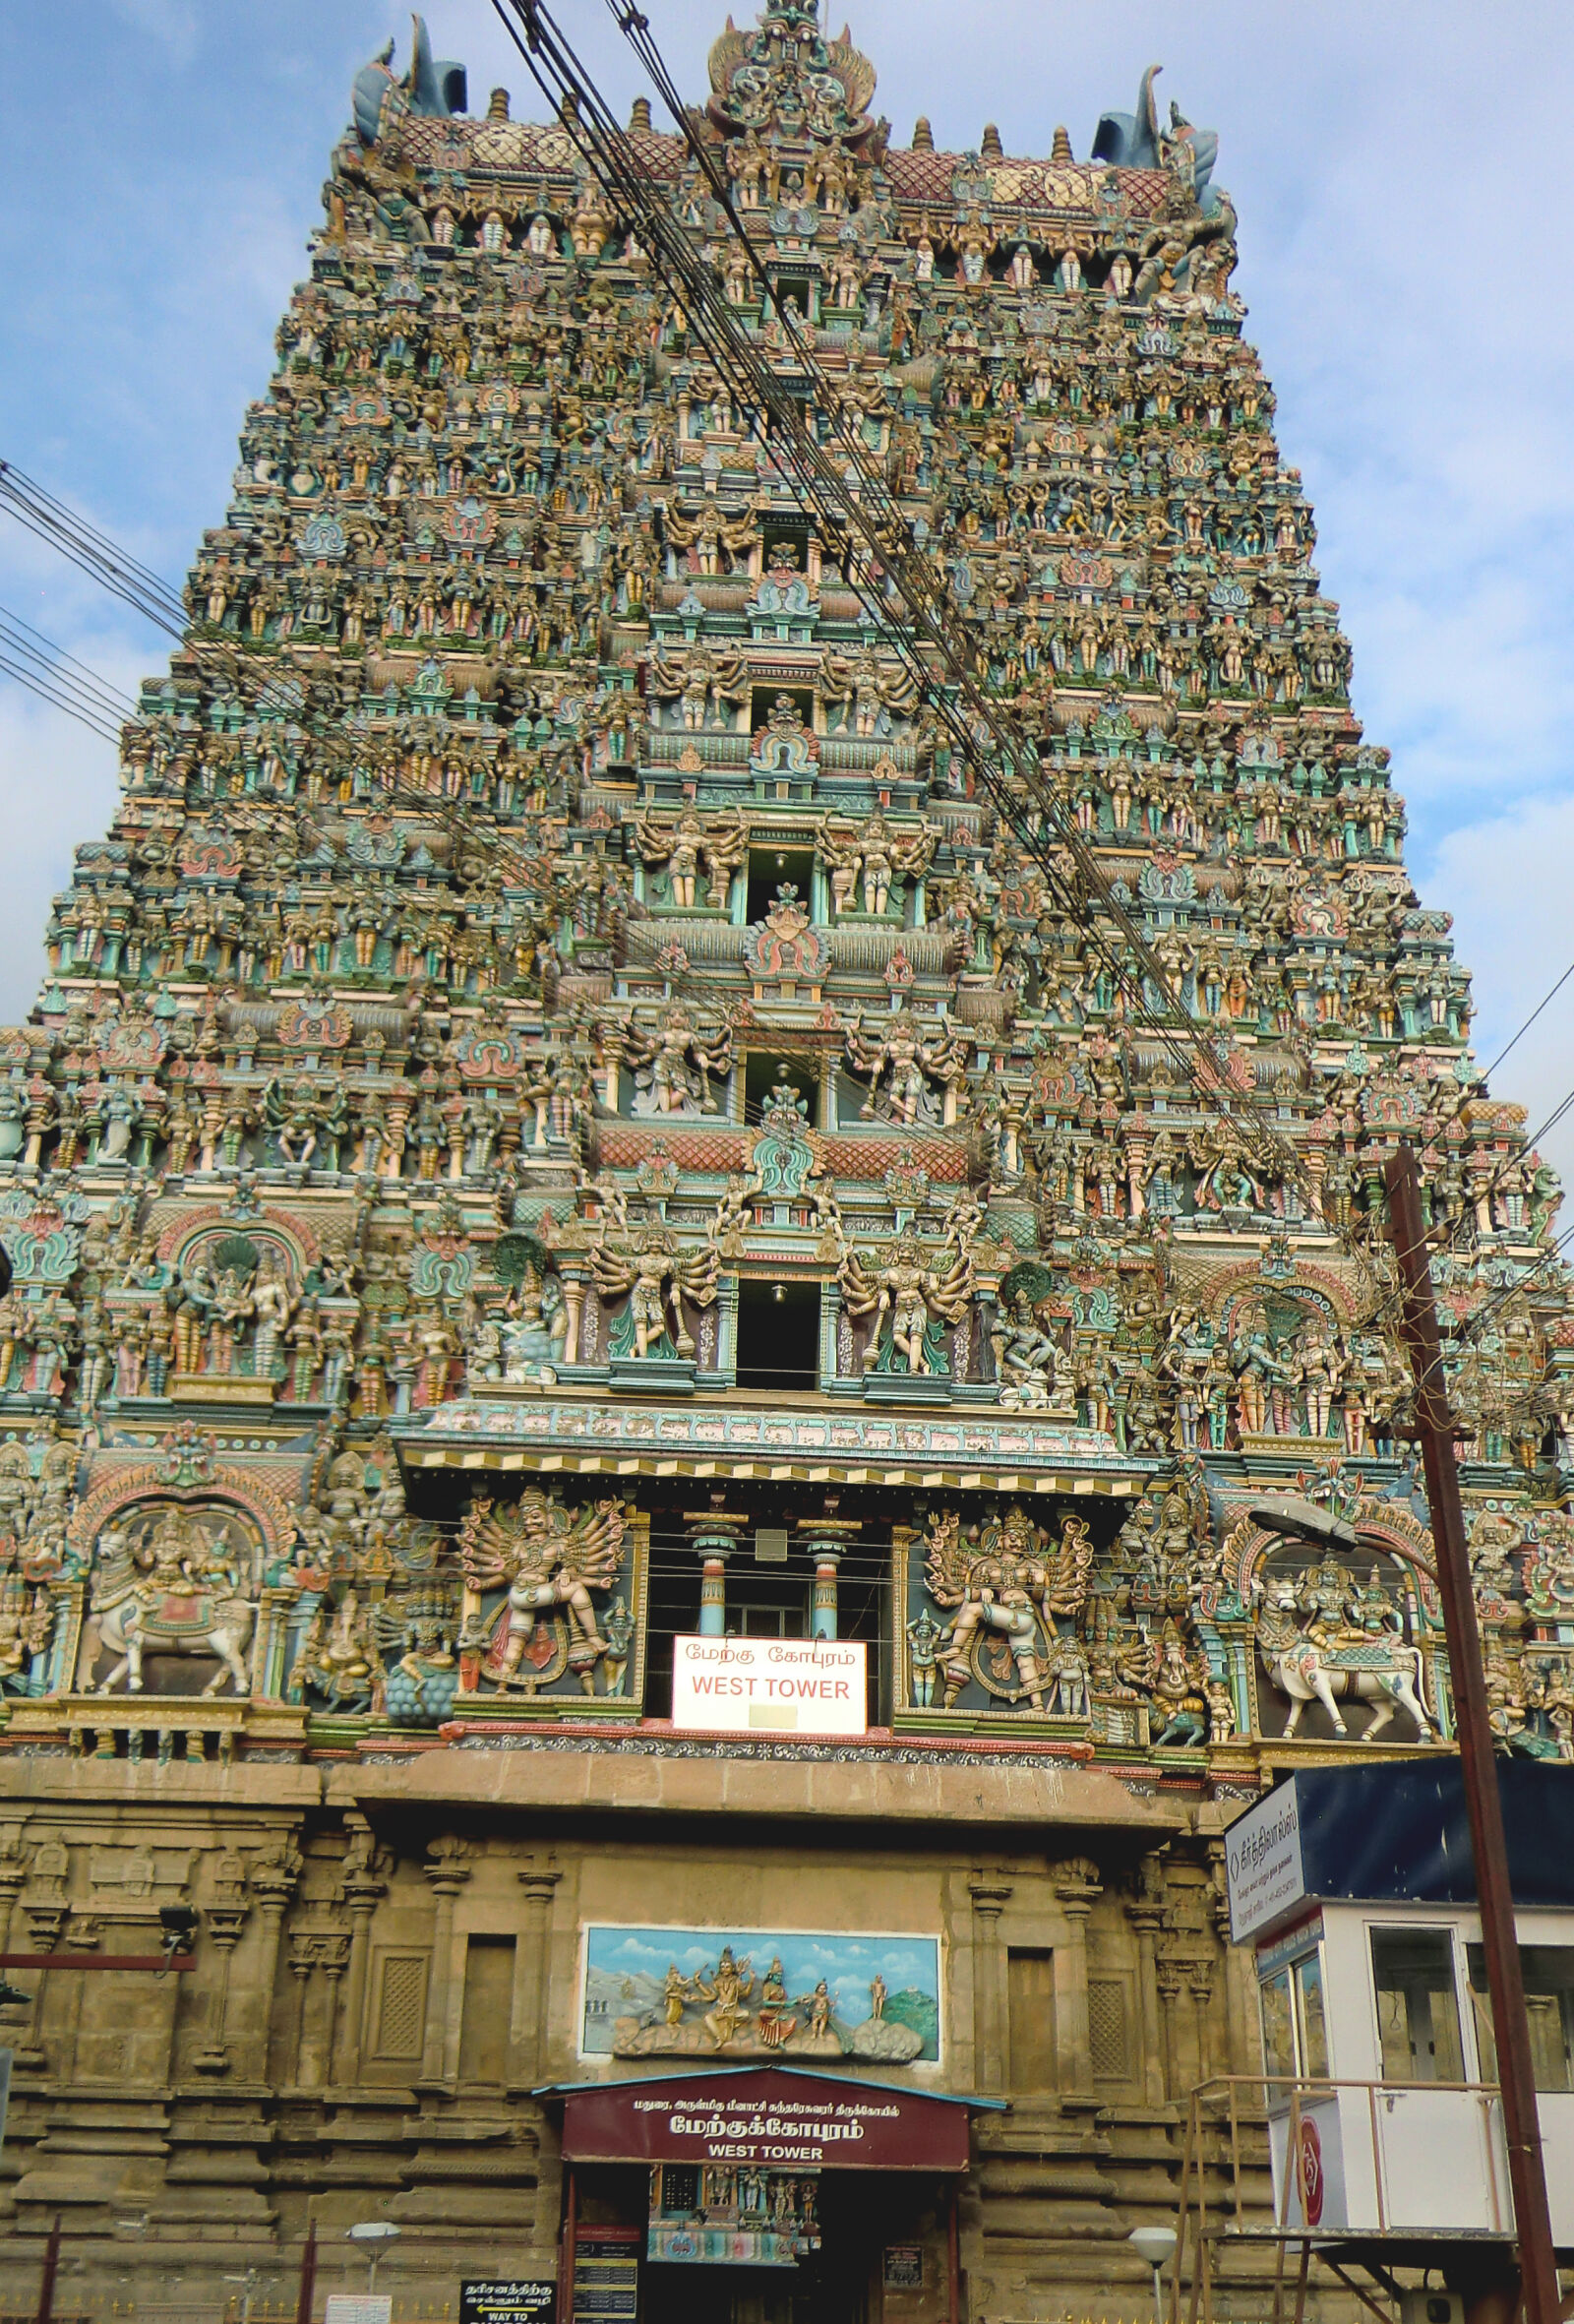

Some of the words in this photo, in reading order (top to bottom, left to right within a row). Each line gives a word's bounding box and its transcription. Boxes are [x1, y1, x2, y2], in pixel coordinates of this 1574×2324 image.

[686, 1643, 755, 1666] மேற்கு
[768, 1646, 855, 1669] கோபுரம்
[692, 1676, 757, 1696] WEST
[765, 1679, 850, 1699] TOWER
[674, 2098, 725, 2112] அருள்மிகு
[726, 2099, 767, 2112] மீனாட்சி
[670, 2113, 865, 2142] மேற்குக்கோபுரம்
[708, 2144, 757, 2158] WEST
[760, 2145, 823, 2160] TOWER
[464, 2283, 553, 2296] தரிசனத்திற்கு
[514, 2313, 528, 2322] TO
